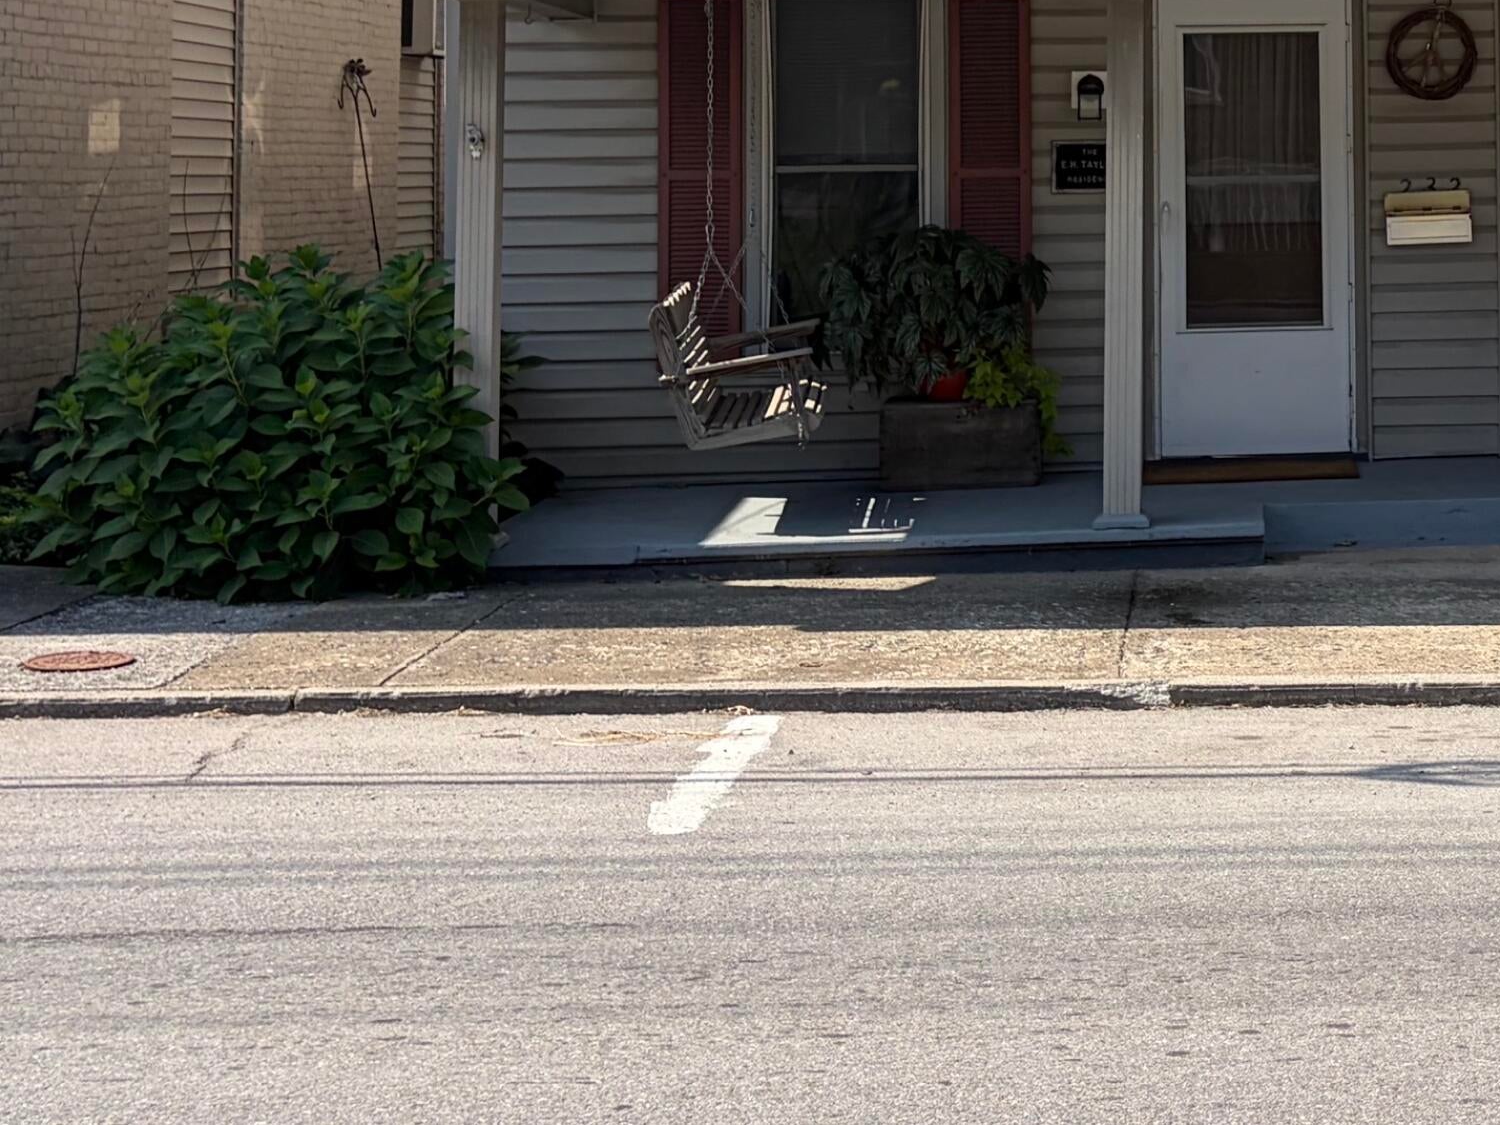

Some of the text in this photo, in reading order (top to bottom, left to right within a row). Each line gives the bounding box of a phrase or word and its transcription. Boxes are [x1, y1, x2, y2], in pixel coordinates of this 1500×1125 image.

[1082, 148, 1097, 156] THE
[1081, 159, 1104, 169] TAYL
[1067, 175, 1104, 183] RESIDEN
